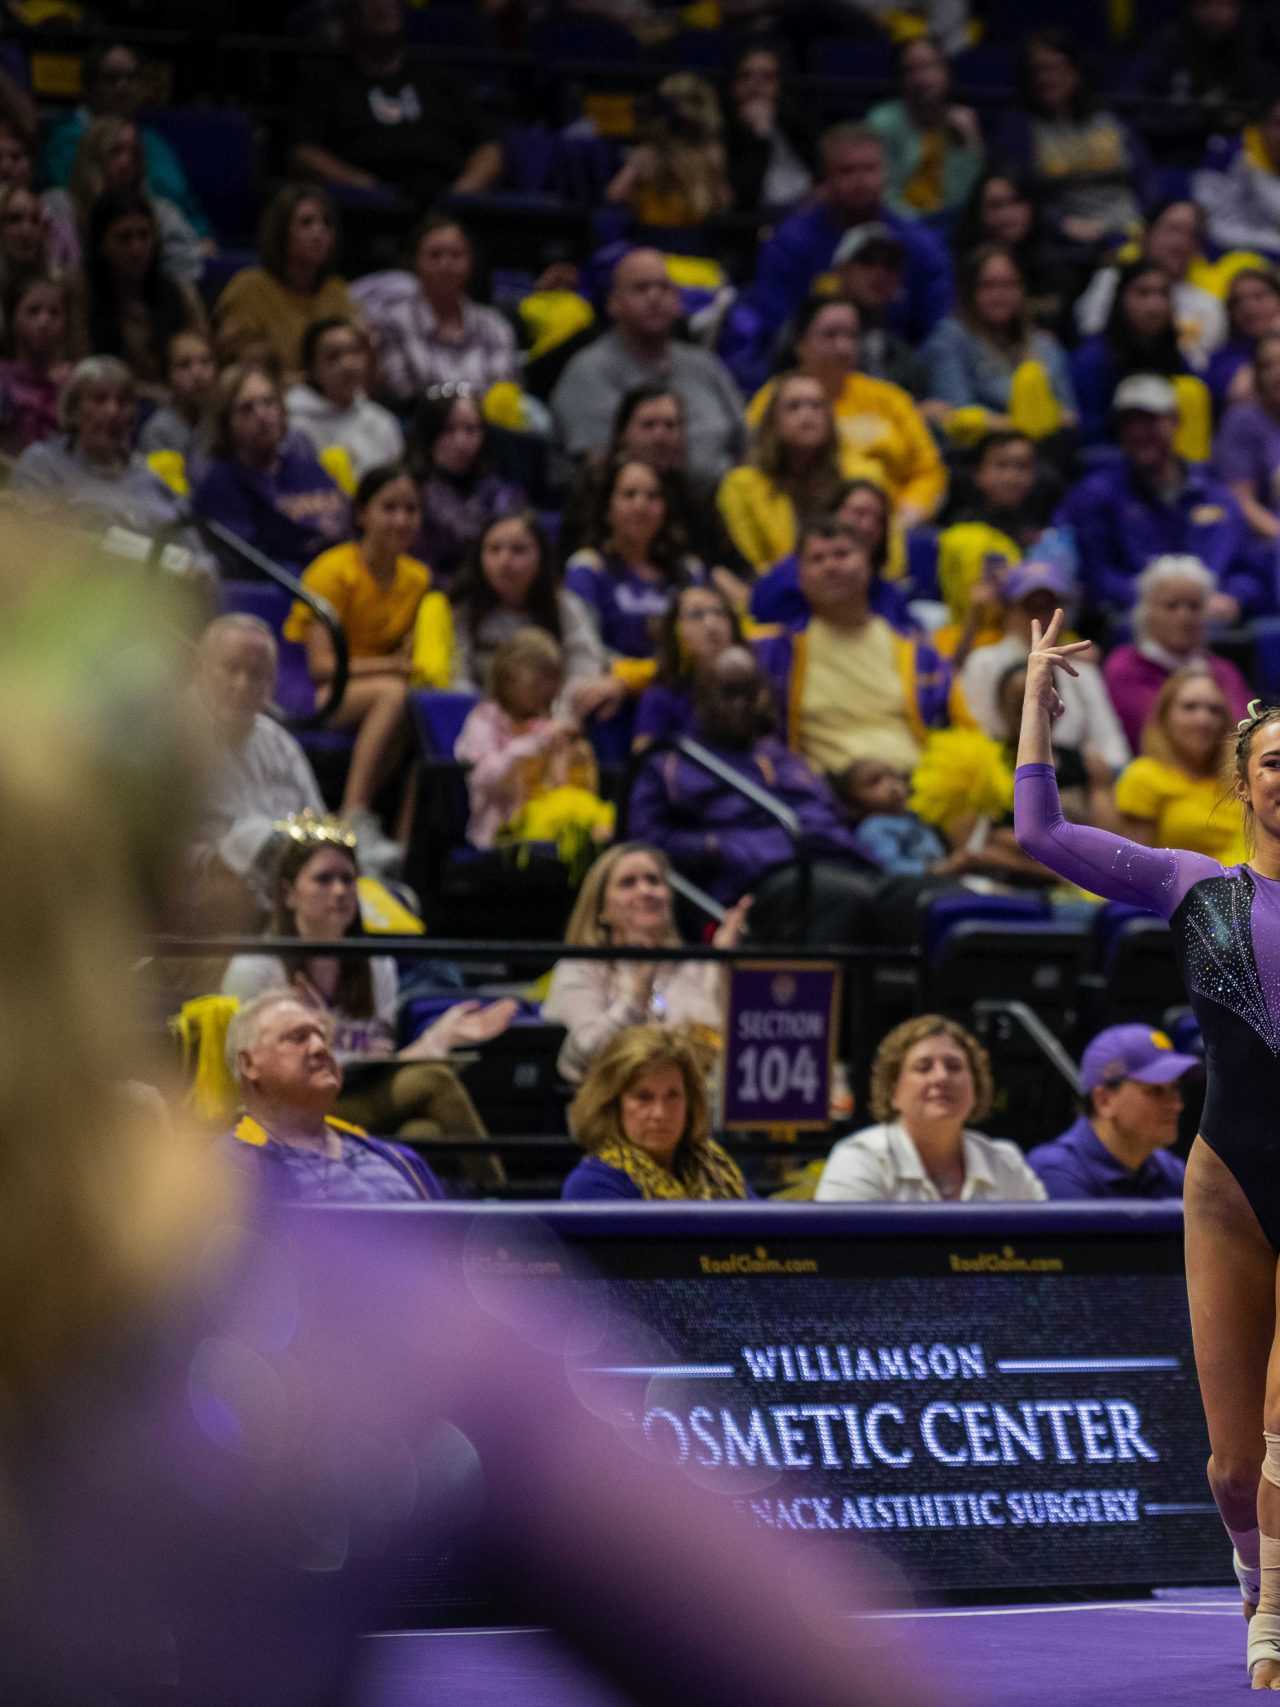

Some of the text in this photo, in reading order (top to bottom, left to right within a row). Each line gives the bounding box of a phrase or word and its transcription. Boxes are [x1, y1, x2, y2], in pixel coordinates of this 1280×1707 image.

[737, 1010, 824, 1040] SECTION
[737, 1045, 818, 1103] 104
[741, 1344, 987, 1383] WILLIAMSON
[616, 1397, 1160, 1470] OSMETIC CENTER
[841, 1491, 1005, 1529] AESTHETIC
[1006, 1488, 1140, 1525] SURGERY
